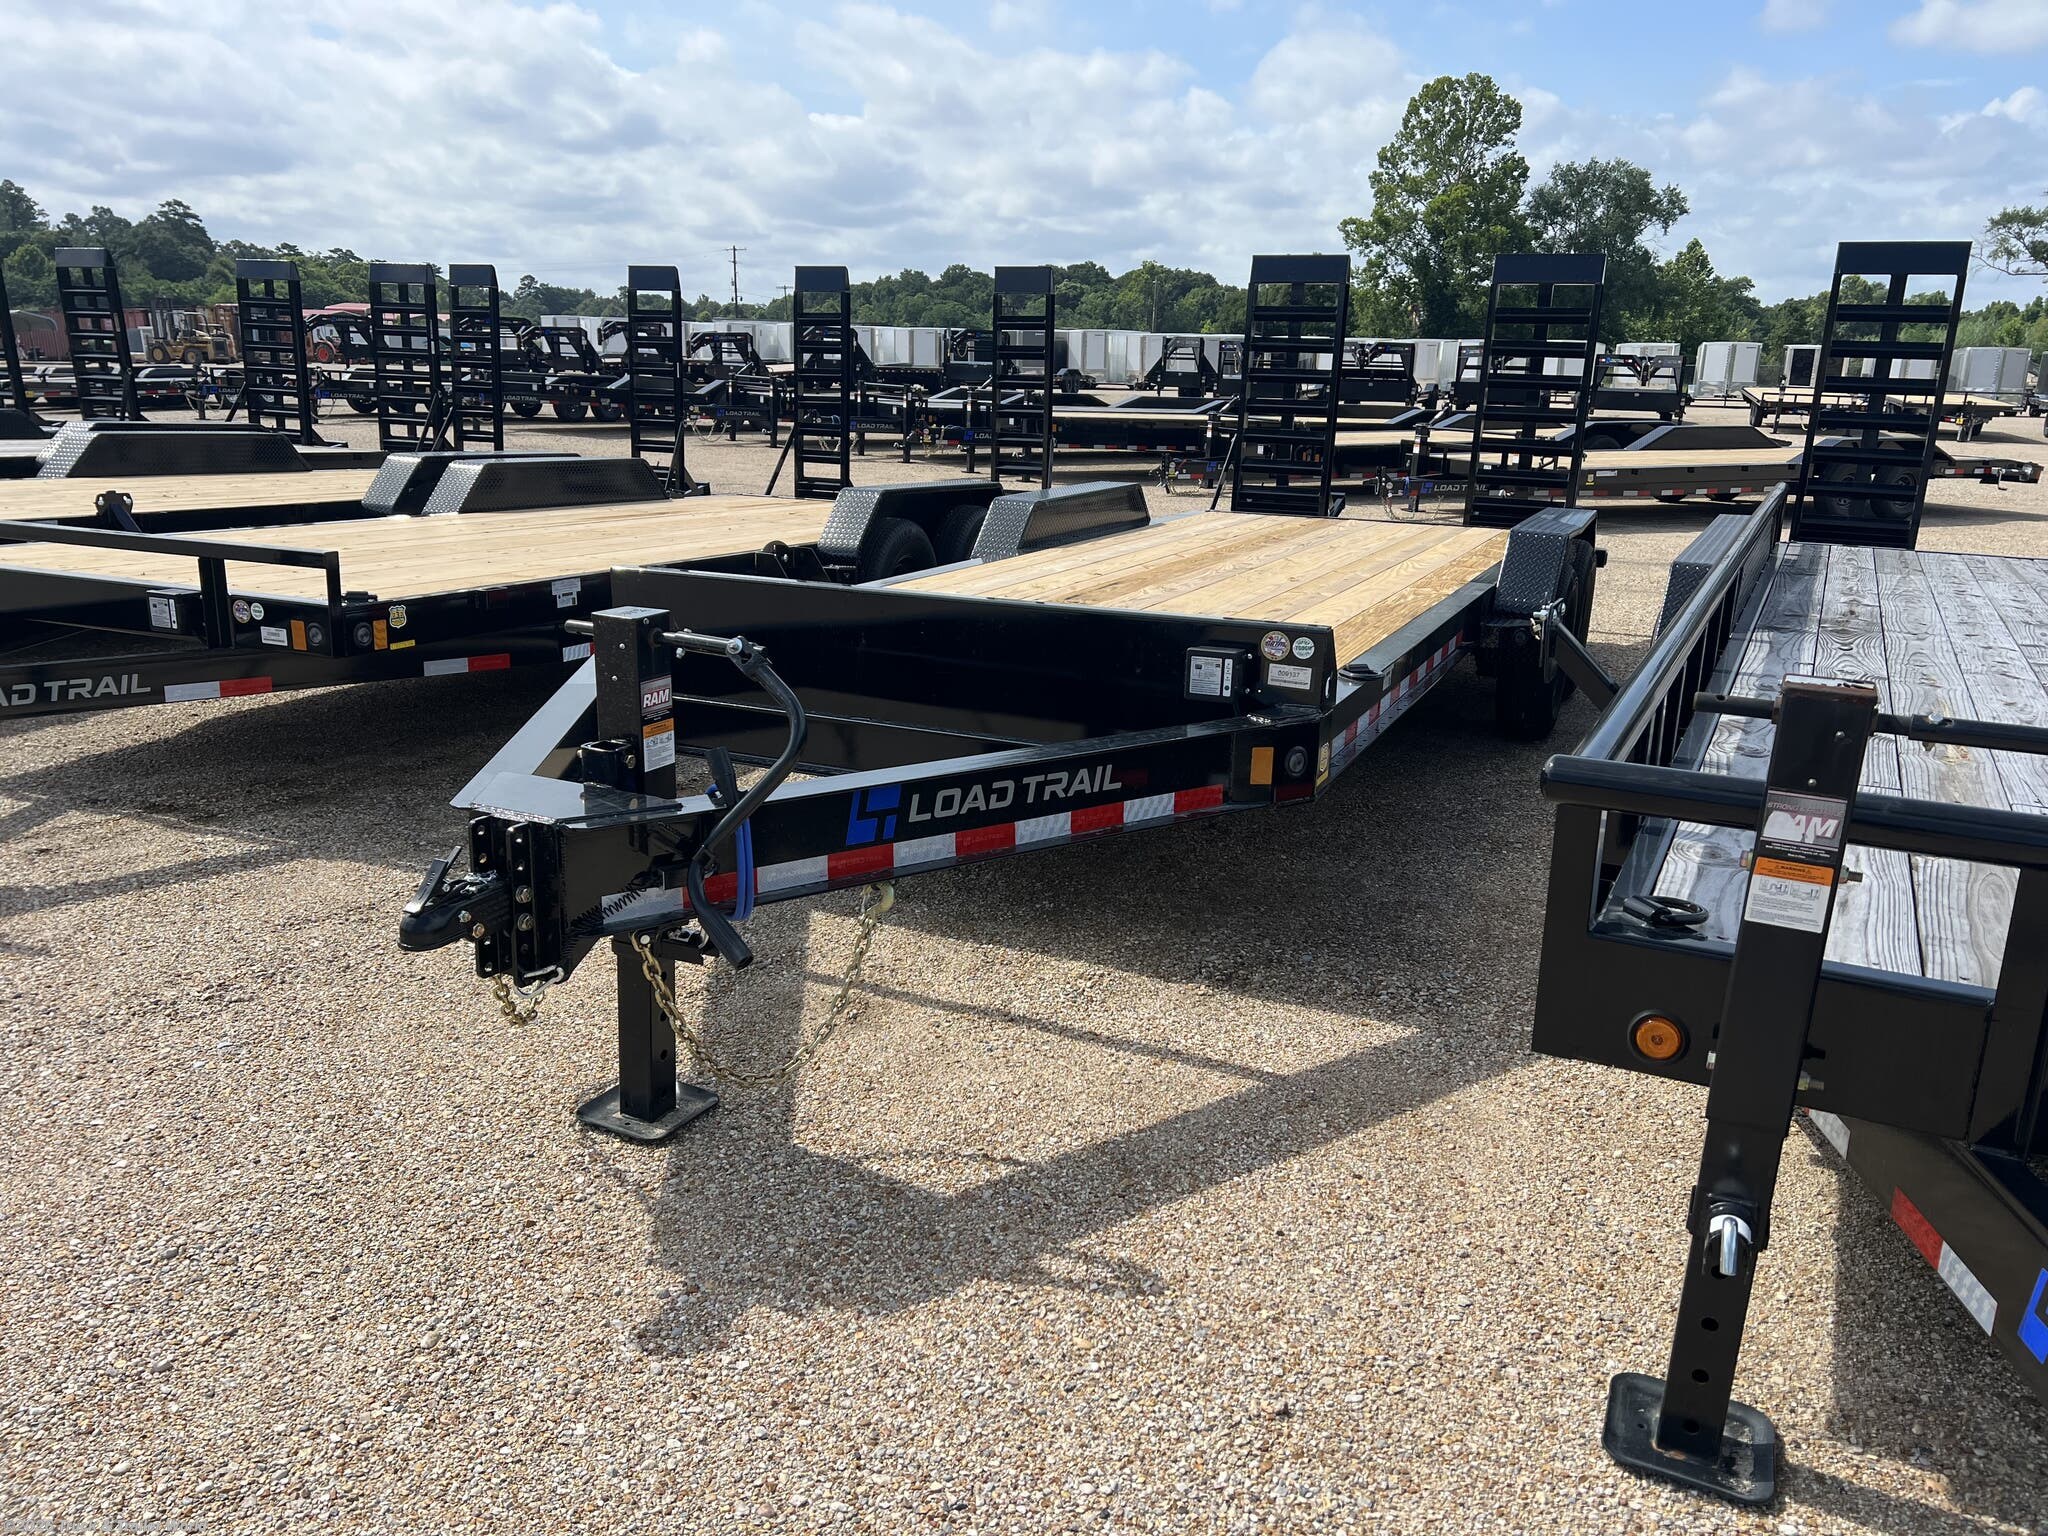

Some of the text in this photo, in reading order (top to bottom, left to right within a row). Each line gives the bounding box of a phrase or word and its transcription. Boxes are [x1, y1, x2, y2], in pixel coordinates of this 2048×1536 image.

[1461, 483, 1488, 491] TAIL
[43, 673, 150, 702] TRAIL
[643, 688, 670, 708] RAM
[908, 764, 1122, 823] LOAD TRAIL
[1765, 811, 1839, 841] AM
